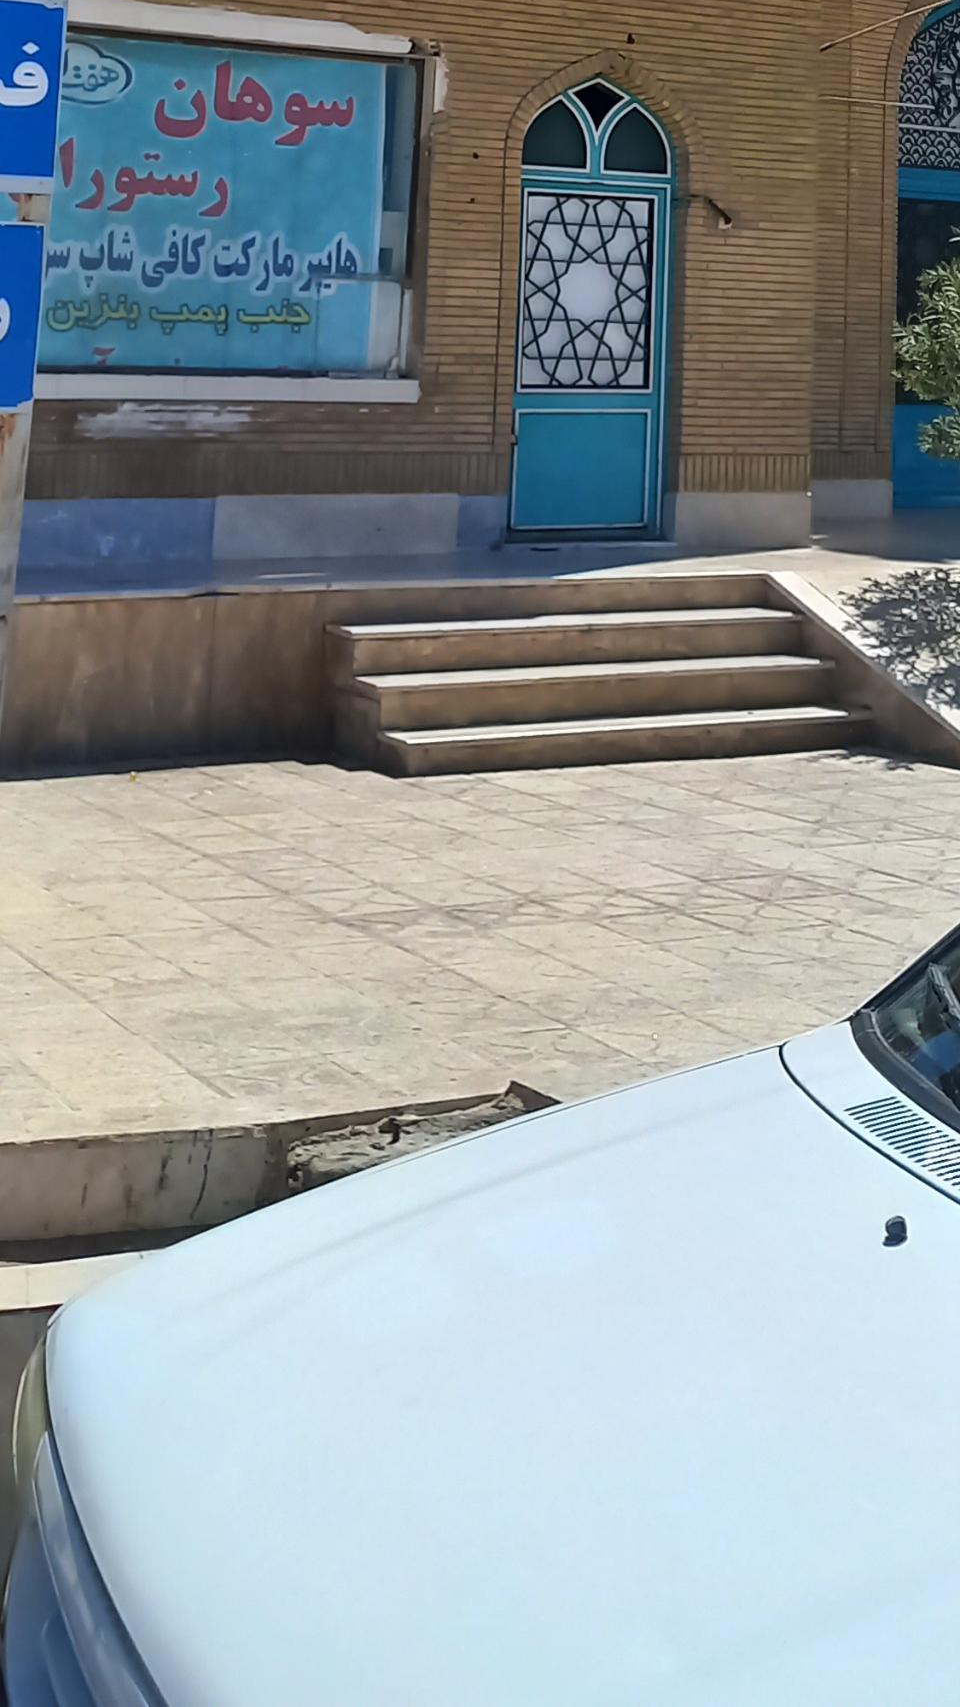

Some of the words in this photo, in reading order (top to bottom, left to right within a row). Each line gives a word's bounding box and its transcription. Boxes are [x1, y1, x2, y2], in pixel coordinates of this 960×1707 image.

[154, 60, 355, 145] سوهان
[58, 137, 229, 217] رستورا
[79, 230, 134, 288] شاپ
[141, 230, 206, 288] کافی
[47, 292, 141, 332] بنزین
[149, 303, 230, 336] پمپ
[236, 298, 312, 333] جنب
